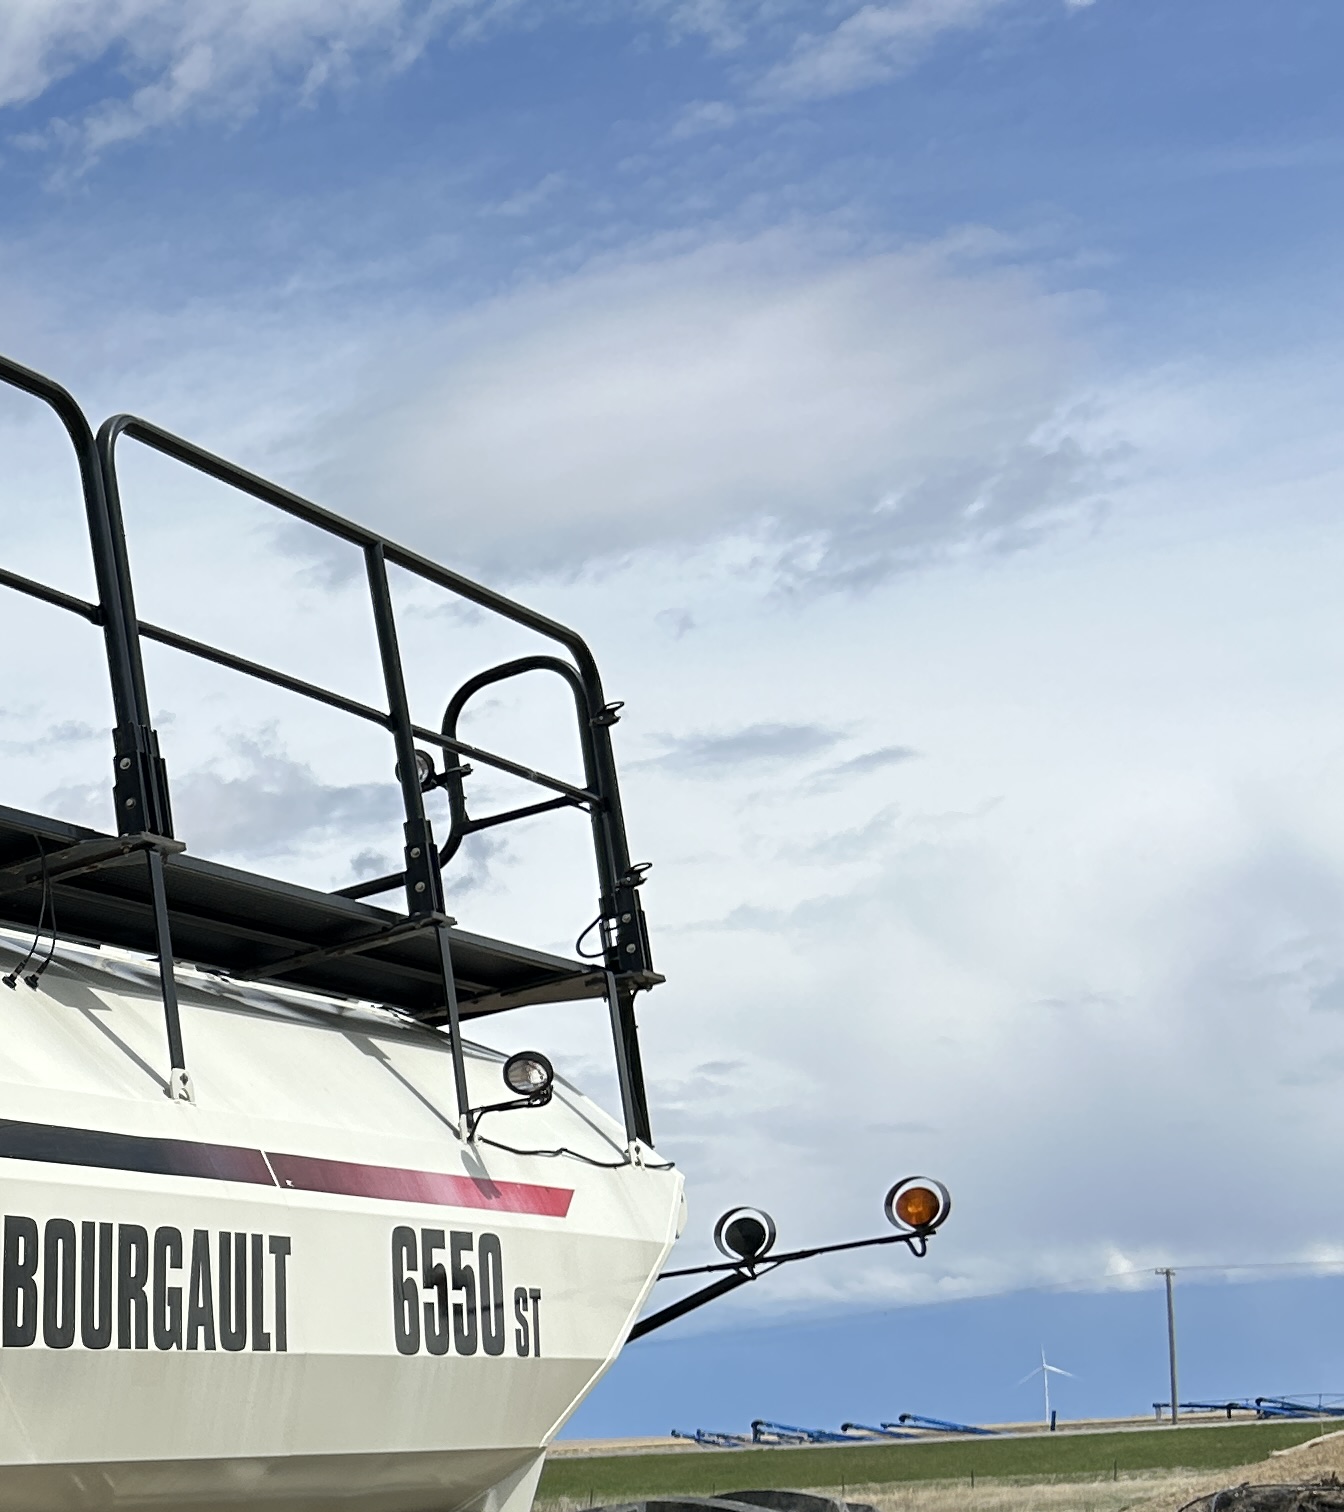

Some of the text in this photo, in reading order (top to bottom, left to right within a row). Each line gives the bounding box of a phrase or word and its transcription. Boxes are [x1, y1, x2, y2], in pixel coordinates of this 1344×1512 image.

[2, 1214, 542, 1358] BOURGAULT 6550 ST
